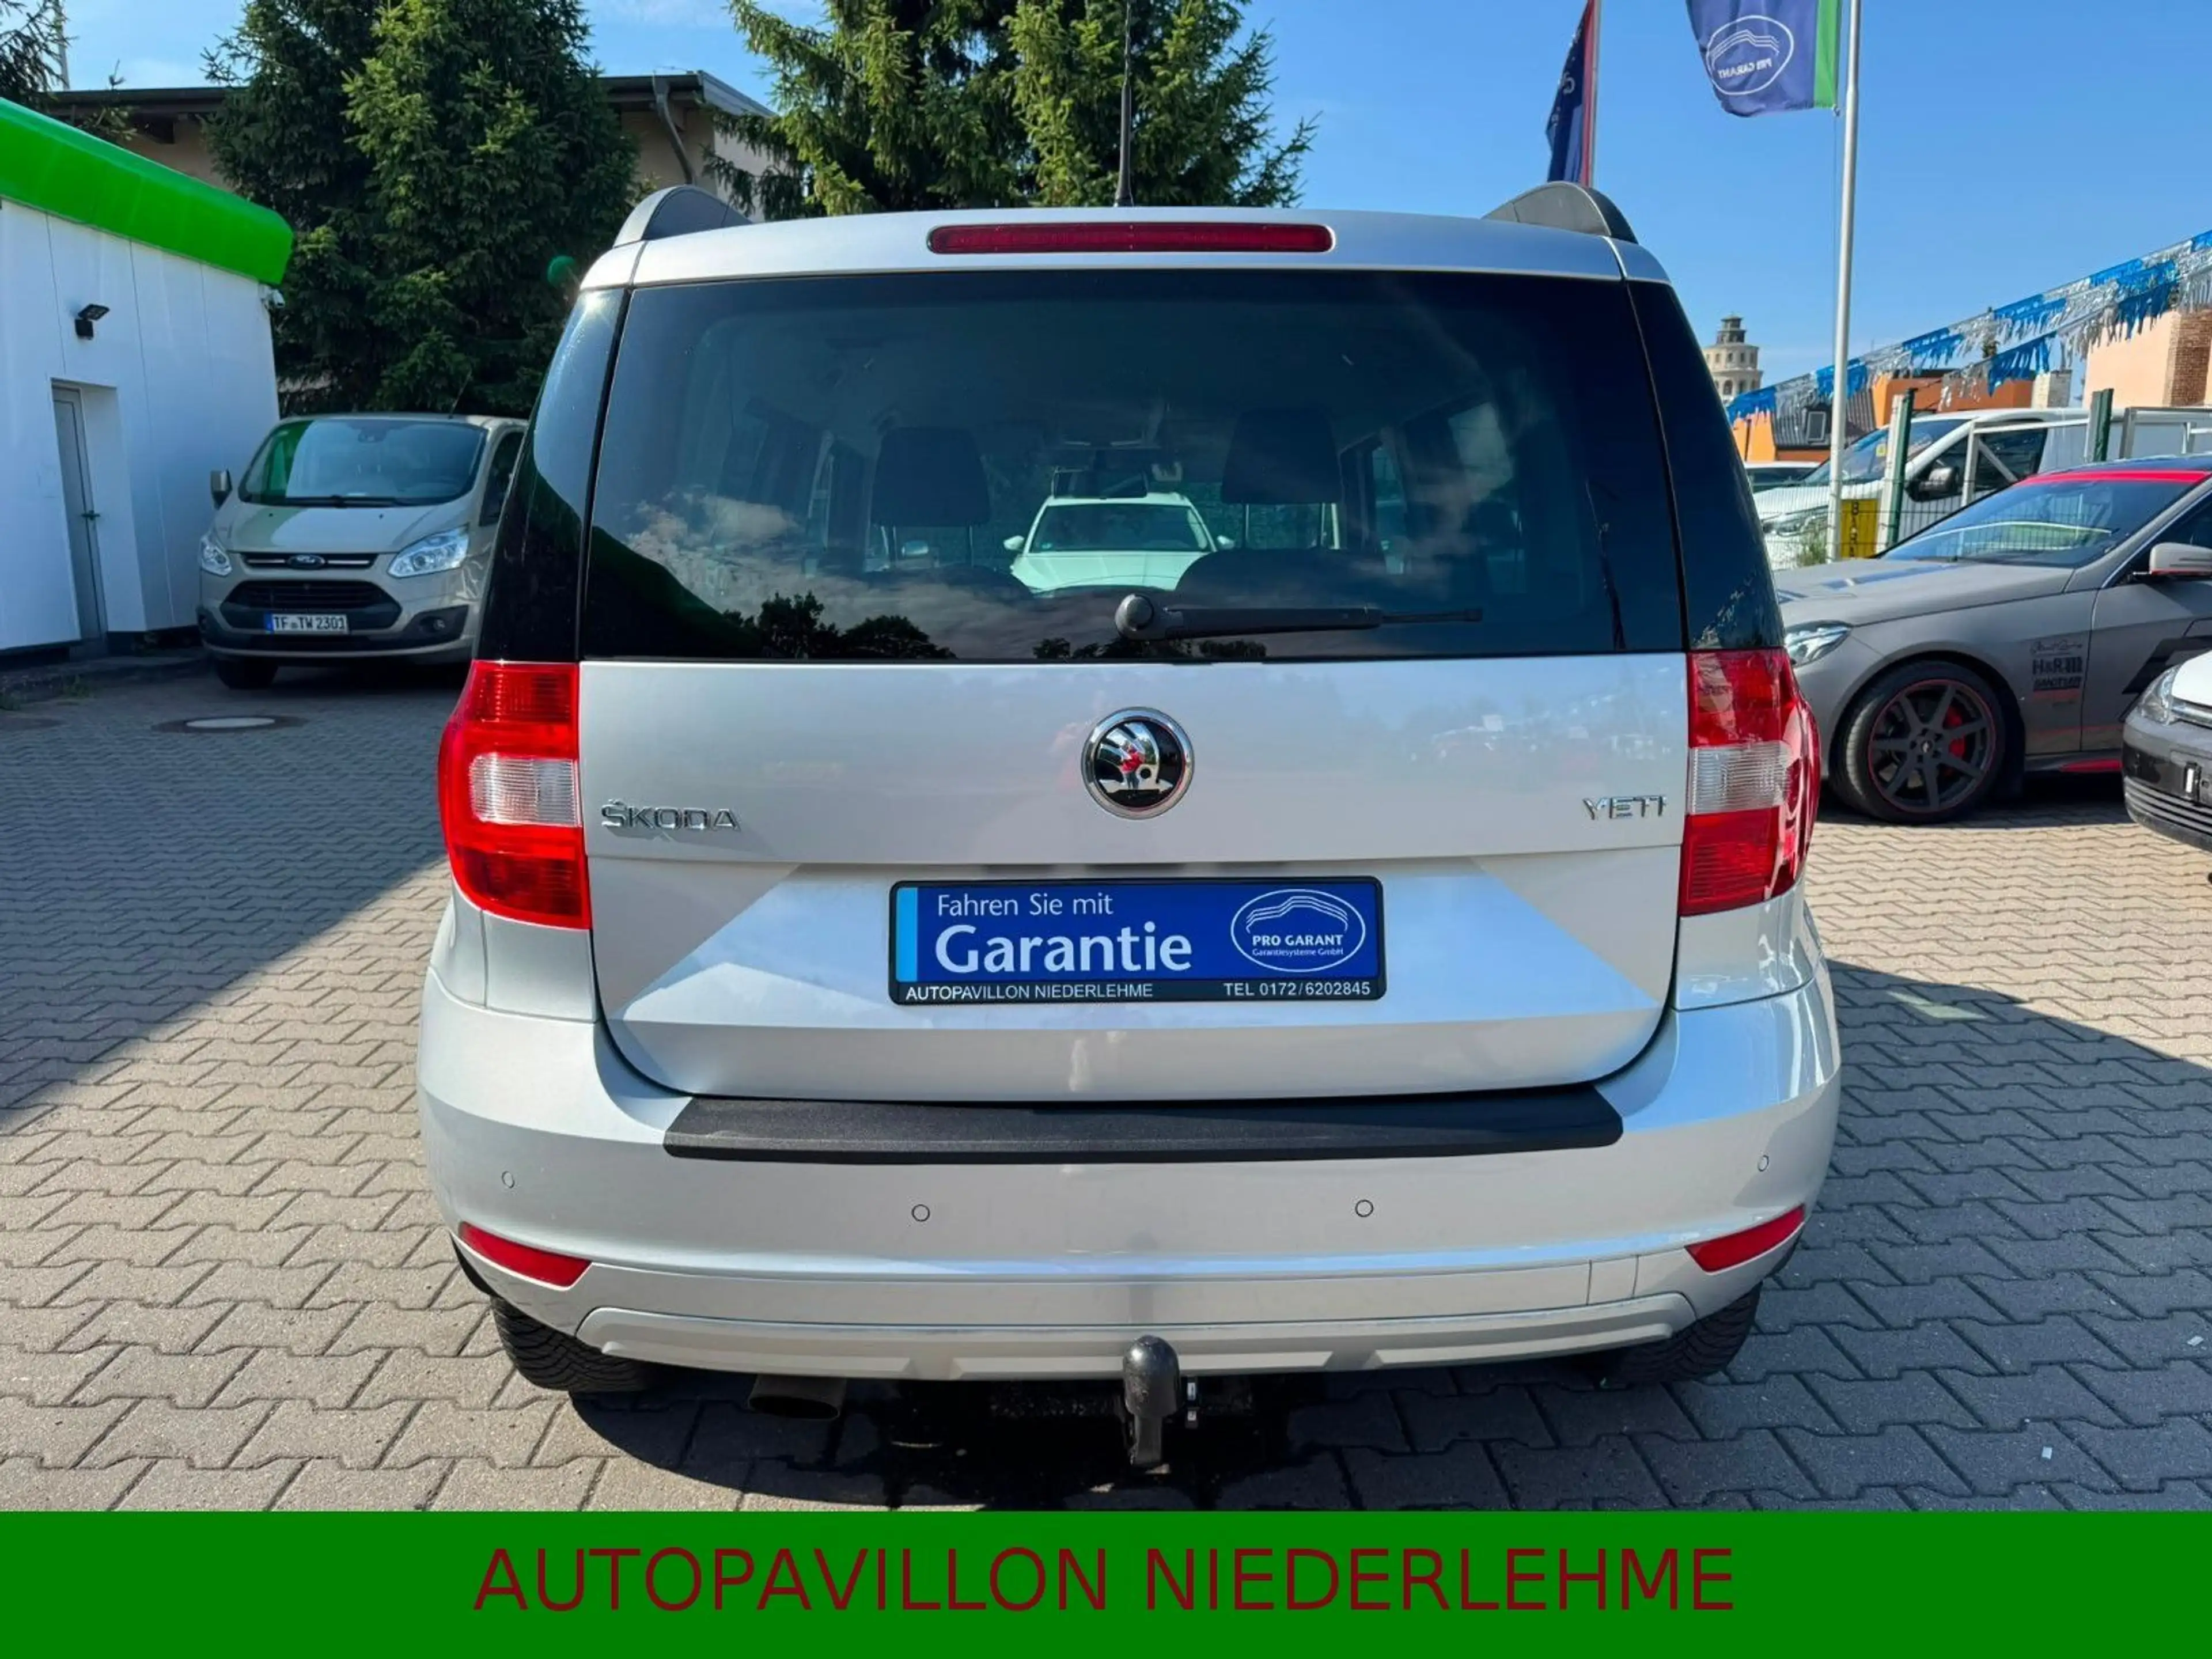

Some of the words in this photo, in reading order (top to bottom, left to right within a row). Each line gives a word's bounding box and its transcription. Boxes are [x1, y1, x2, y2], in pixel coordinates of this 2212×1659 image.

[317, 616, 345, 629] 2301
[601, 798, 741, 831] ŠKODA
[1582, 794, 1666, 820] YETI
[937, 893, 1018, 916] Fahren
[1029, 893, 1063, 915] Sie
[1073, 892, 1113, 915] mit
[935, 921, 1192, 974] Garantie
[1252, 934, 1281, 946] PRO
[1285, 934, 1343, 946] GARANT
[1252, 948, 1316, 957] Garantiesysteme
[1317, 948, 1344, 956] GmbH
[905, 984, 1030, 1001] AUTOPAVILLON
[1035, 984, 1153, 998] NIEDERLEHME
[1224, 983, 1255, 997] TEL
[1259, 981, 1371, 997] 0172/6202845
